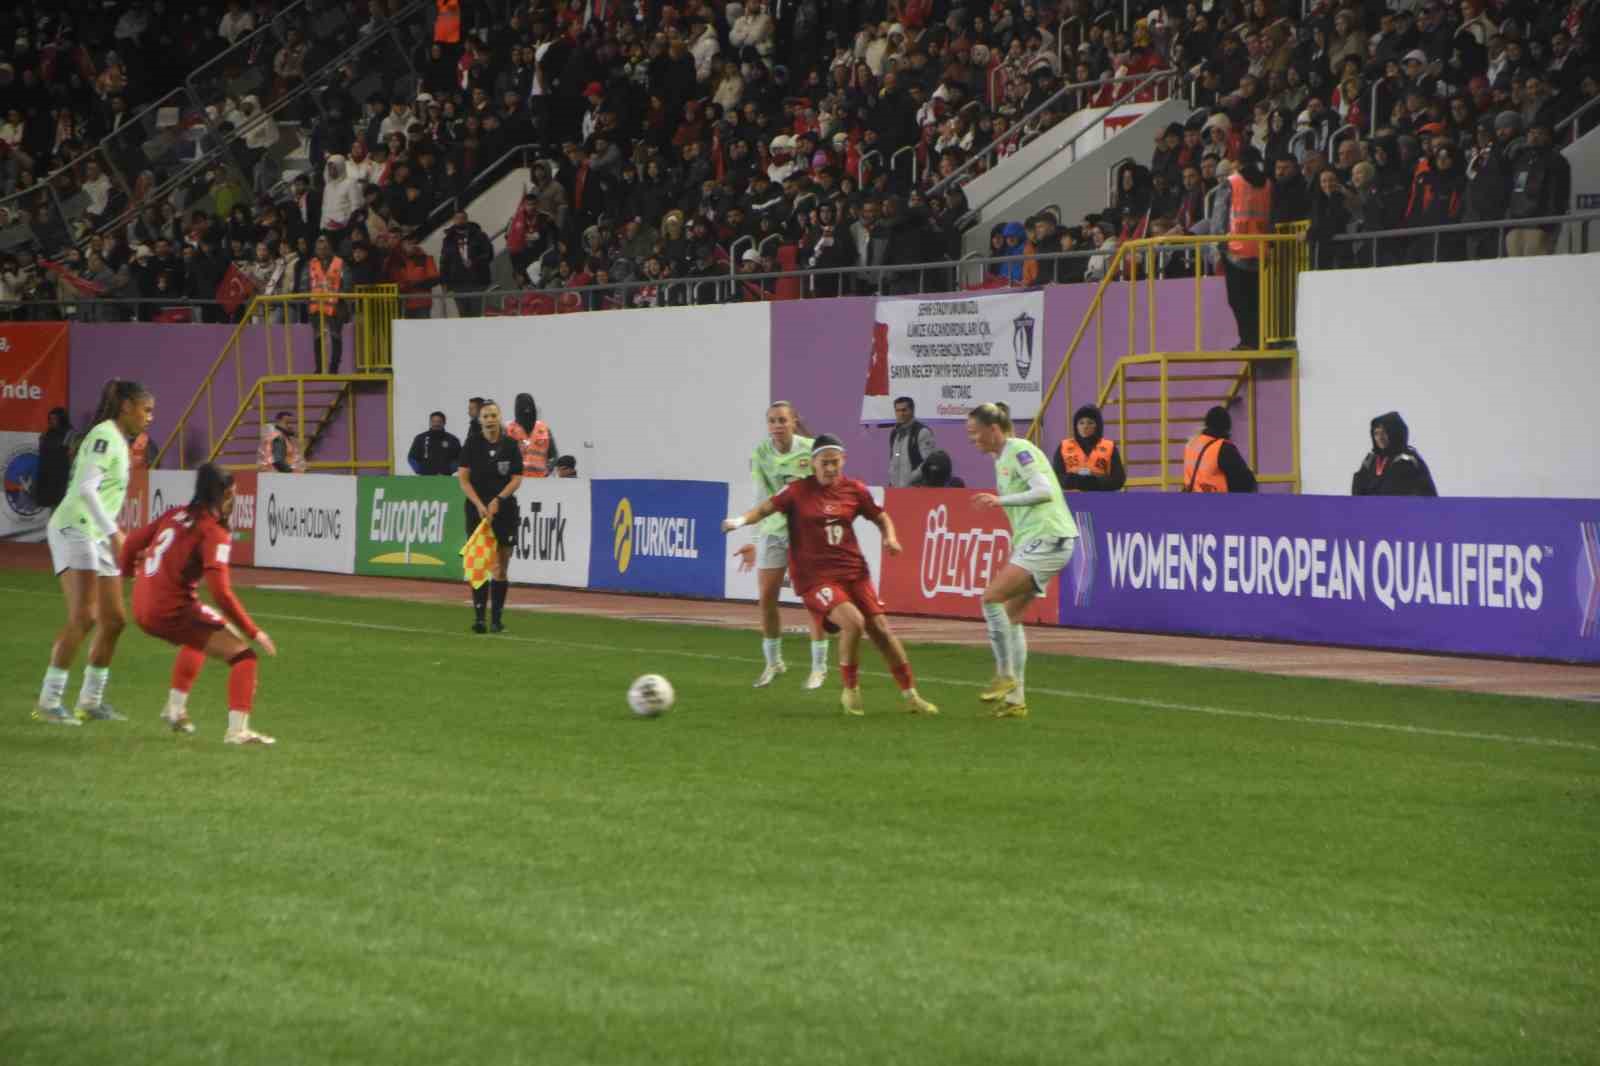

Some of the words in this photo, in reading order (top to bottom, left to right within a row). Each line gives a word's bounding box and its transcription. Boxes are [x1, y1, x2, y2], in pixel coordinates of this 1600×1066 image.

[912, 364, 933, 377] RECEP
[278, 507, 299, 536] NATA
[300, 508, 341, 540] HOLDING
[370, 488, 448, 561] Europcar
[633, 516, 698, 559] TURKCELL
[825, 525, 843, 545] 19
[145, 528, 174, 577] 3
[921, 504, 1011, 598] ÜLKER
[1106, 532, 1217, 592] WOMEN'S
[1223, 535, 1366, 601] EUROPEAN
[816, 587, 833, 606] 19
